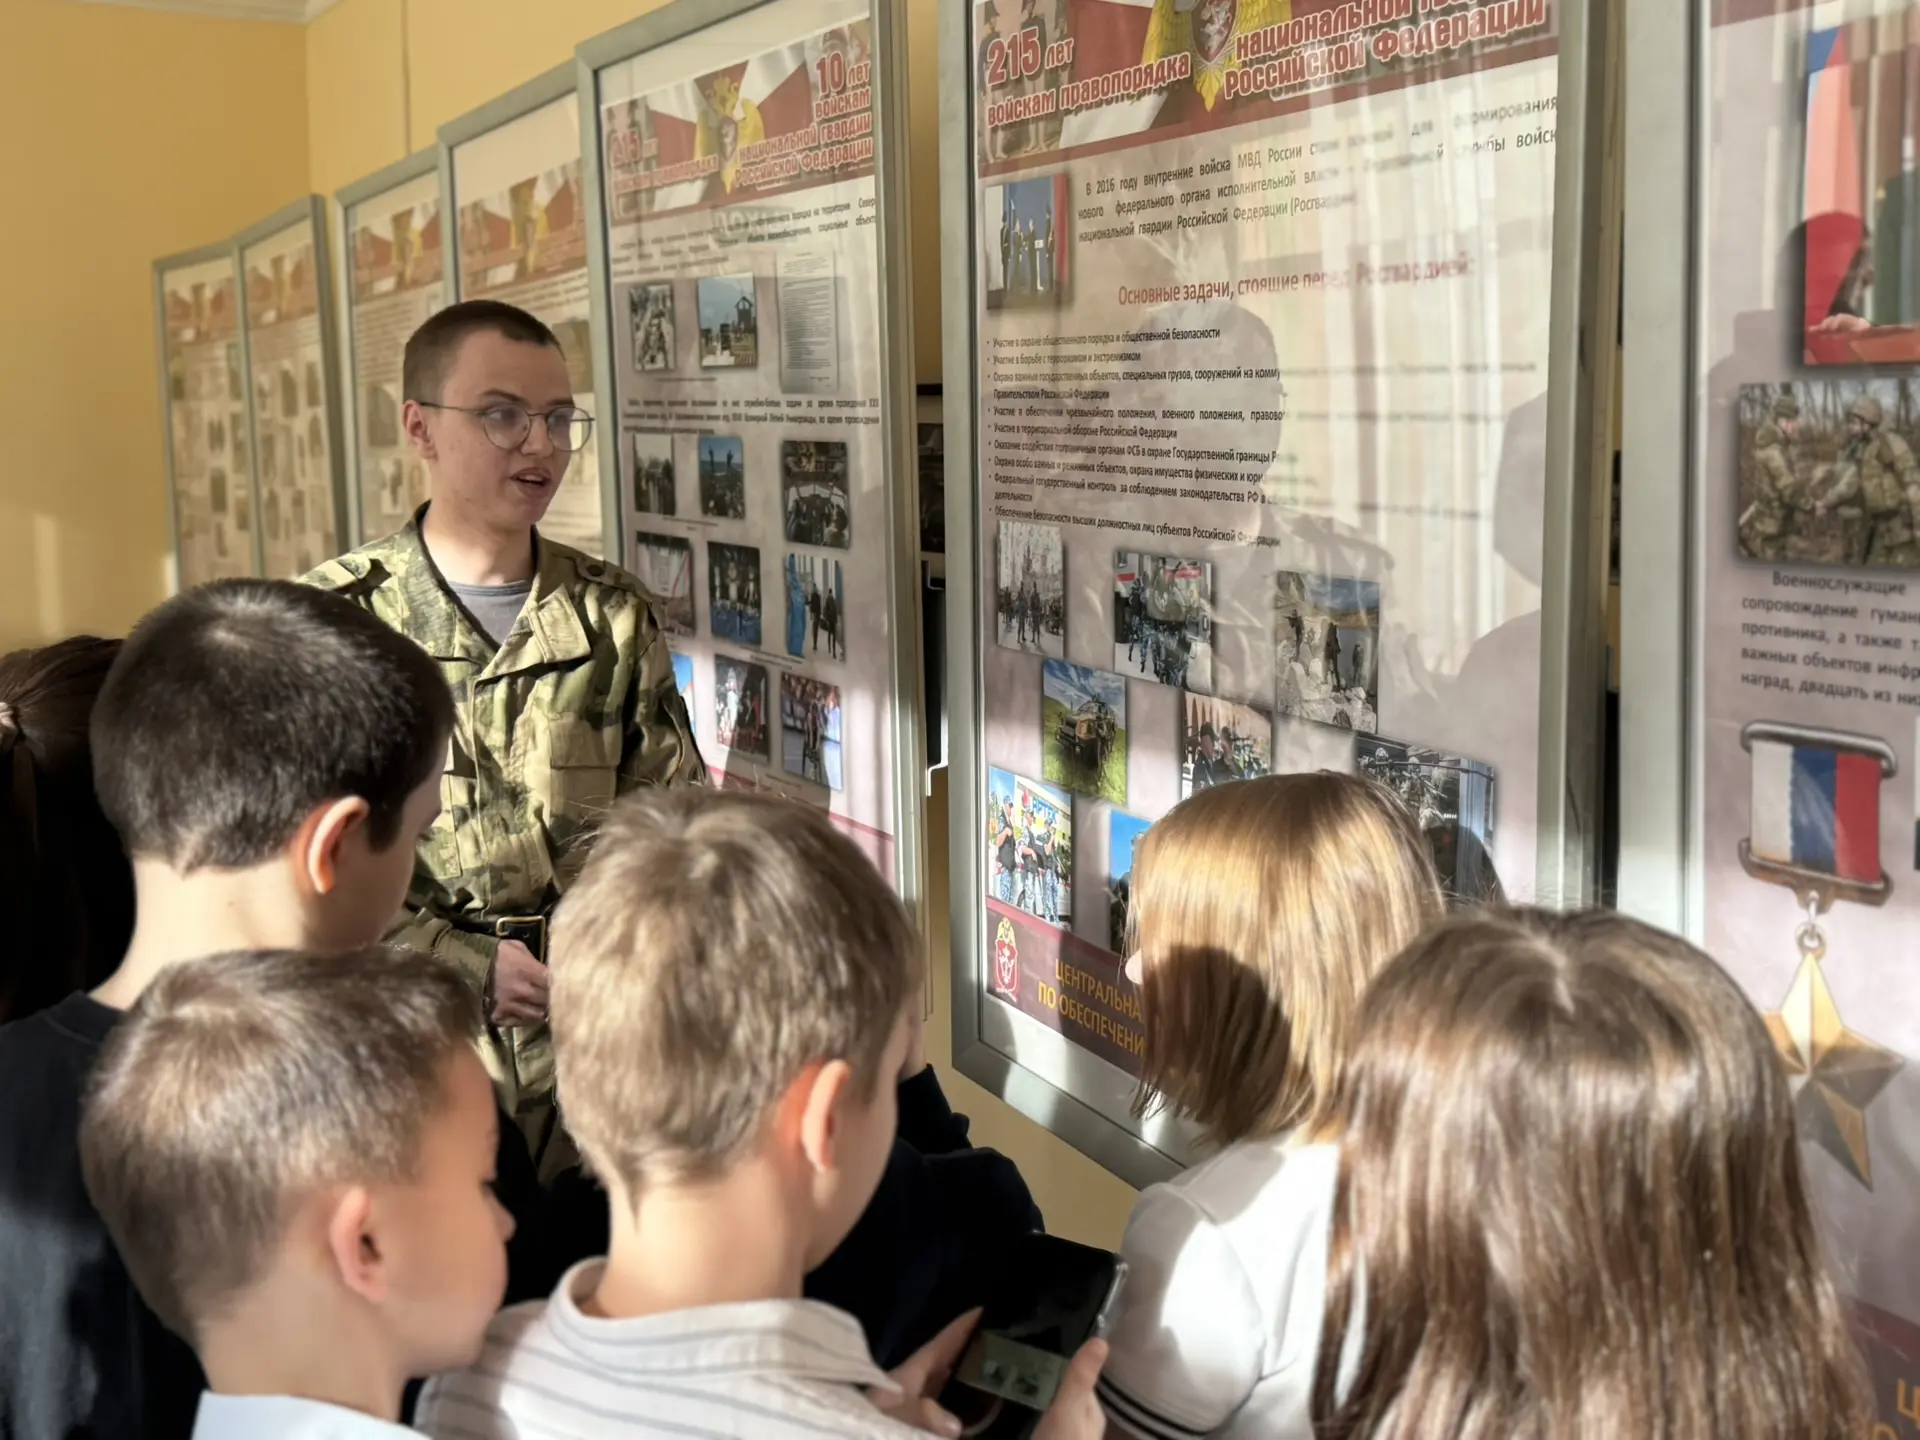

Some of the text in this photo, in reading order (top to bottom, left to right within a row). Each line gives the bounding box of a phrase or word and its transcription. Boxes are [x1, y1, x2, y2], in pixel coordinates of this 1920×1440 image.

[987, 27, 1075, 87] 215 лет
[1224, 0, 1547, 99] Российской Федерации
[816, 51, 870, 96] 10 лет
[815, 86, 871, 121] войскам
[988, 52, 1191, 127] войскам правопорядка
[820, 112, 872, 144] гвардии
[801, 137, 873, 172] Федерации
[1096, 177, 1115, 195] 2016
[1120, 177, 1138, 191] году
[1143, 166, 1194, 188] внутренние
[1199, 158, 1231, 176] войска
[1237, 150, 1262, 169] МВД
[1268, 145, 1302, 162] России
[1078, 206, 1104, 221] нового
[1115, 192, 1174, 217] федерального
[1180, 188, 1211, 207] органа
[1217, 170, 1296, 198] исполнительной
[1078, 222, 1134, 243] национальной
[1138, 219, 1173, 236] гвардии
[1177, 208, 1228, 230] Российской
[1233, 202, 1288, 224] Федерации
[1118, 283, 1180, 305] Основные
[1183, 279, 1234, 302] задачи,
[1237, 274, 1299, 295] стоящие
[1121, 328, 1171, 344] общественной
[1172, 328, 1220, 340] безопасности
[1122, 371, 1166, 382] специальных
[1168, 370, 1193, 382] грузов,
[1194, 366, 1241, 382] сооружений
[1243, 369, 1253, 378] на
[1118, 409, 1157, 420] положения,
[1162, 409, 1195, 419] военного
[1199, 410, 1245, 422] положения,
[1100, 425, 1137, 437] Российской
[1139, 426, 1177, 440] Федерации
[1127, 445, 1140, 456] ФСБ
[1147, 449, 1171, 460] охране
[1172, 447, 1235, 461] Государственной
[1236, 450, 1270, 463] границы
[1129, 466, 1153, 477] охрана
[1154, 467, 1193, 479] имущества
[1194, 468, 1238, 482] физических
[1120, 484, 1127, 493] за
[1129, 483, 1177, 497] соблюдением
[1179, 488, 1245, 502] законодательства
[1247, 491, 1259, 503] РФ
[1097, 518, 1141, 532] должностных
[1142, 524, 1155, 535] лиц
[1156, 523, 1191, 537] субъектов
[1193, 526, 1236, 541] Российской
[1772, 570, 1907, 596] Военнослужащие
[1742, 597, 1859, 619] сопровождение
[1742, 622, 1831, 645] противника,
[1837, 633, 1847, 644] а
[1855, 633, 1904, 650] также
[1741, 647, 1798, 664] важных
[1802, 651, 1872, 674] объектов
[1741, 672, 1794, 693] наград,
[1799, 679, 1869, 700] двадцать
[1873, 690, 1892, 703] из
[1038, 981, 1057, 1010] ПО
